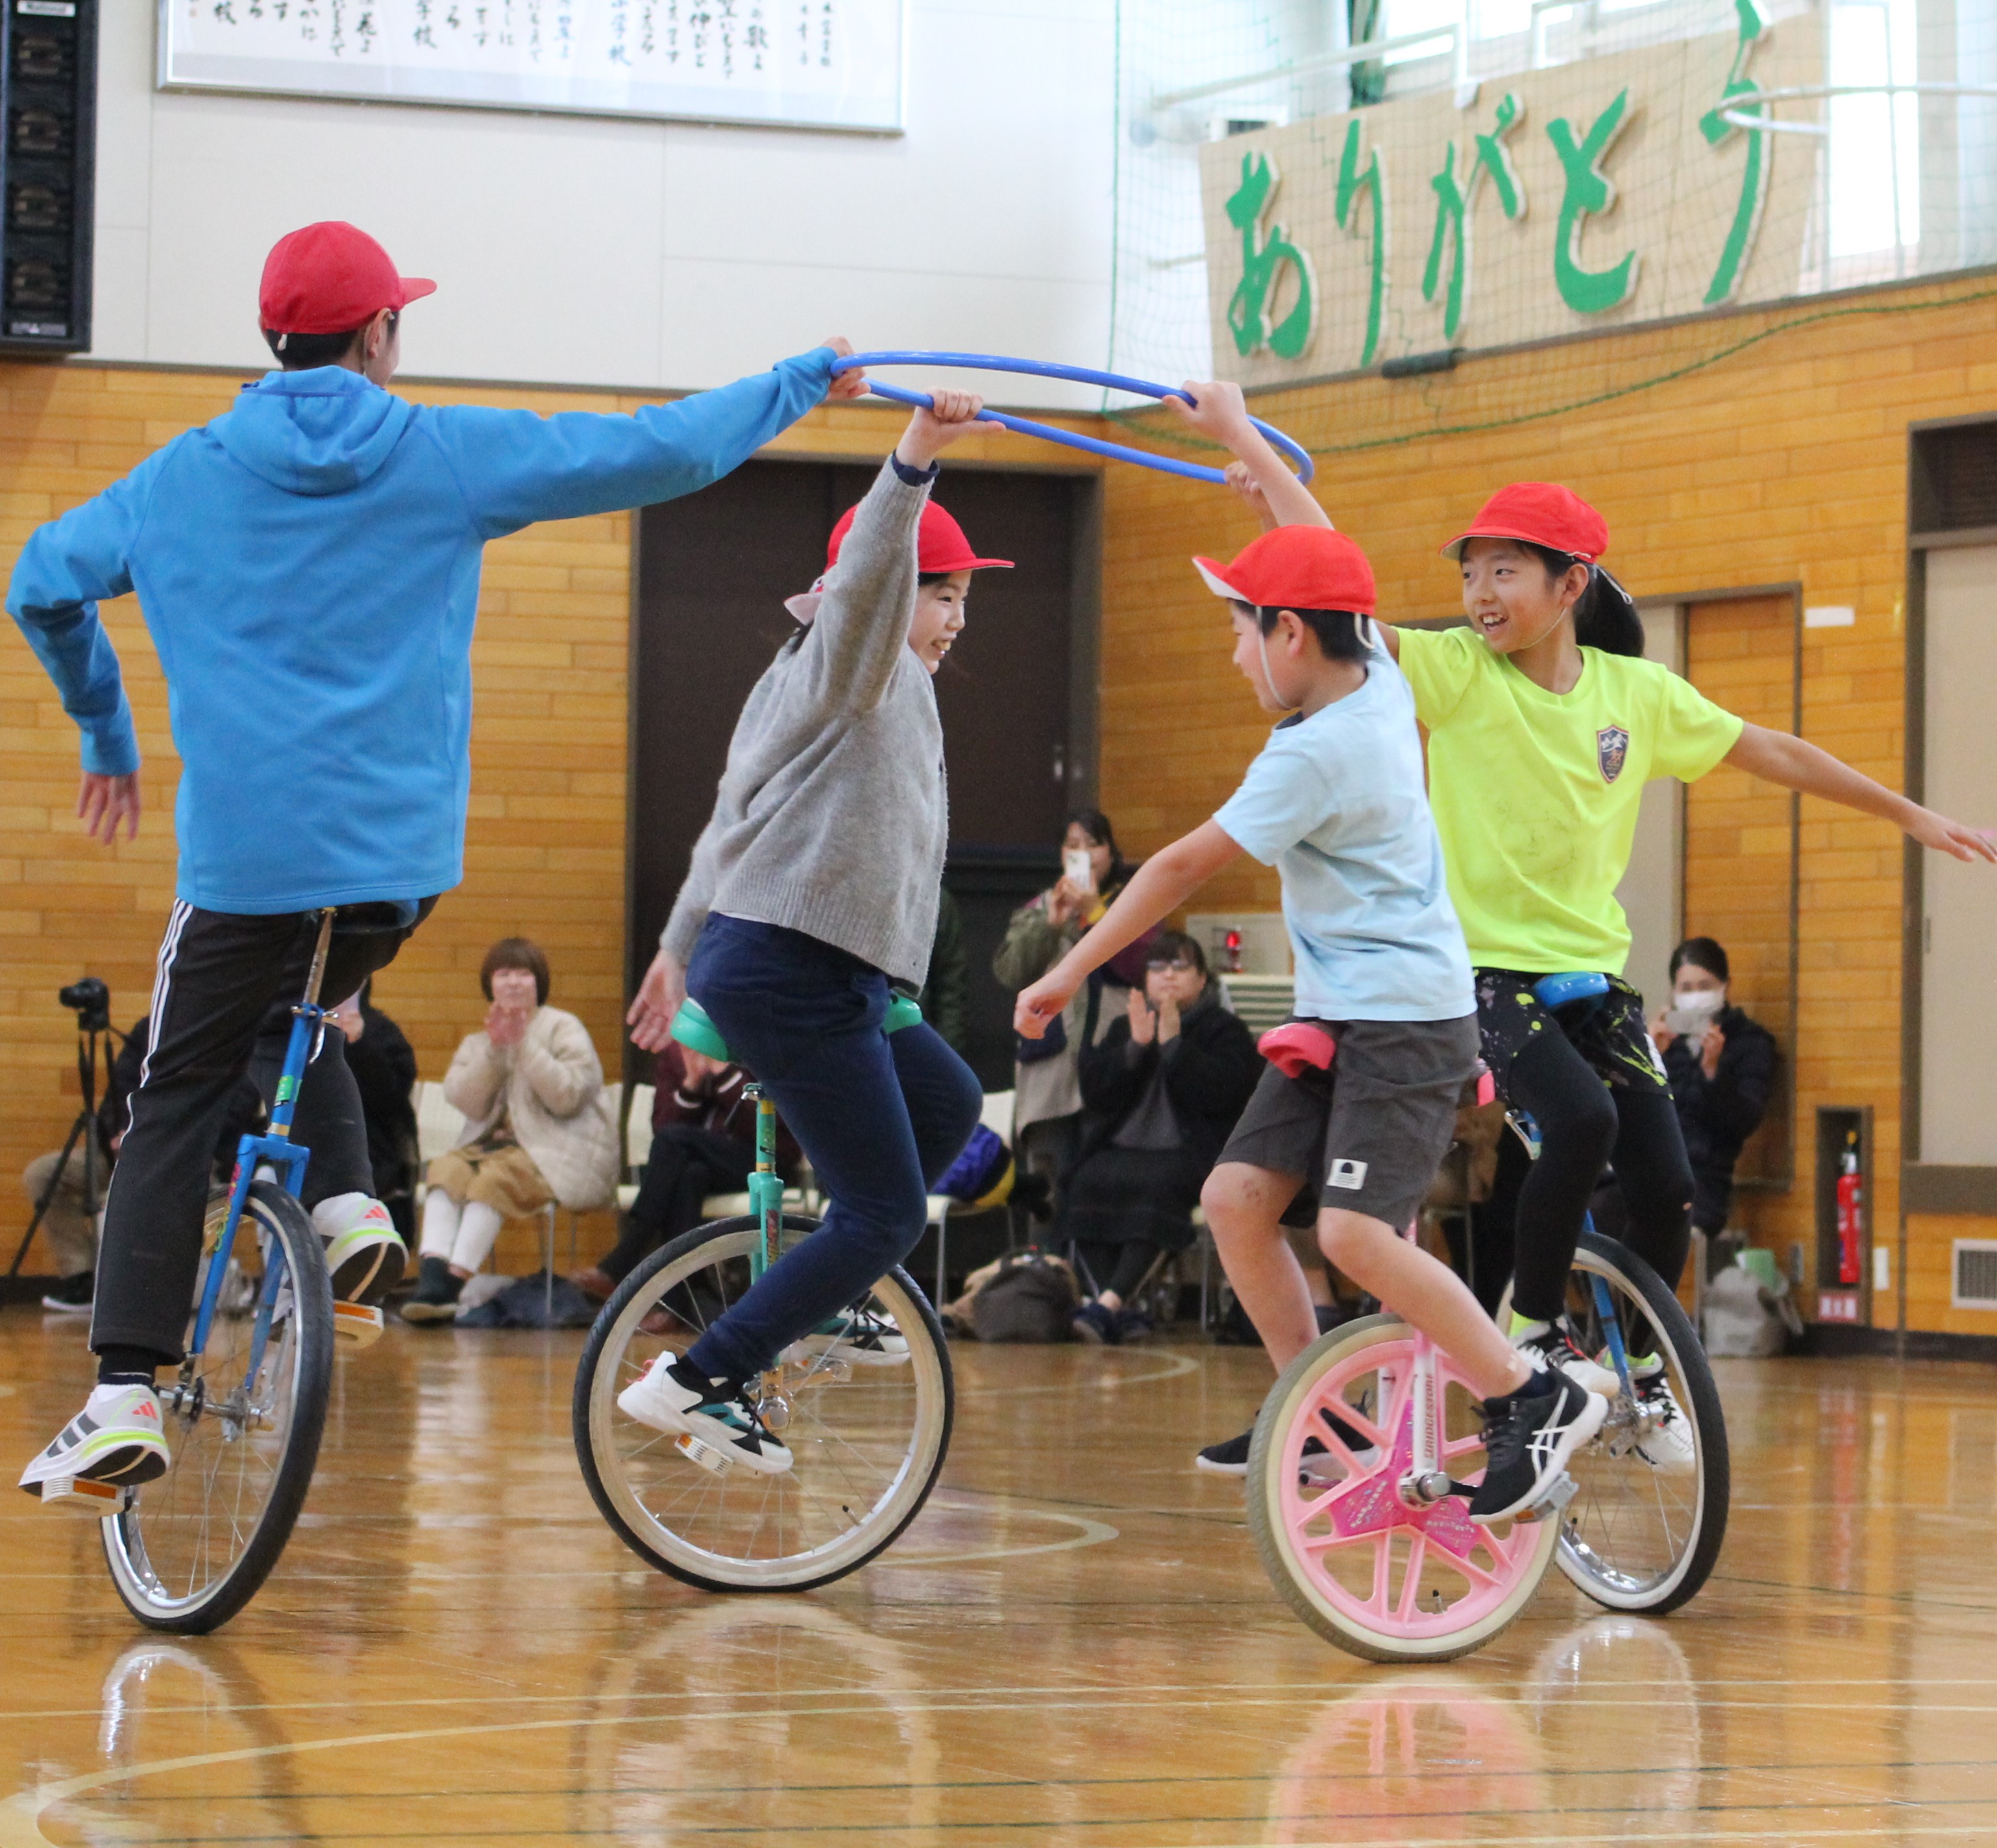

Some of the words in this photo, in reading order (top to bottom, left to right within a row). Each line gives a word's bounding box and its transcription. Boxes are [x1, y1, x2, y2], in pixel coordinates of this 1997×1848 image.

[1225, 0, 1768, 368] ありがとう
